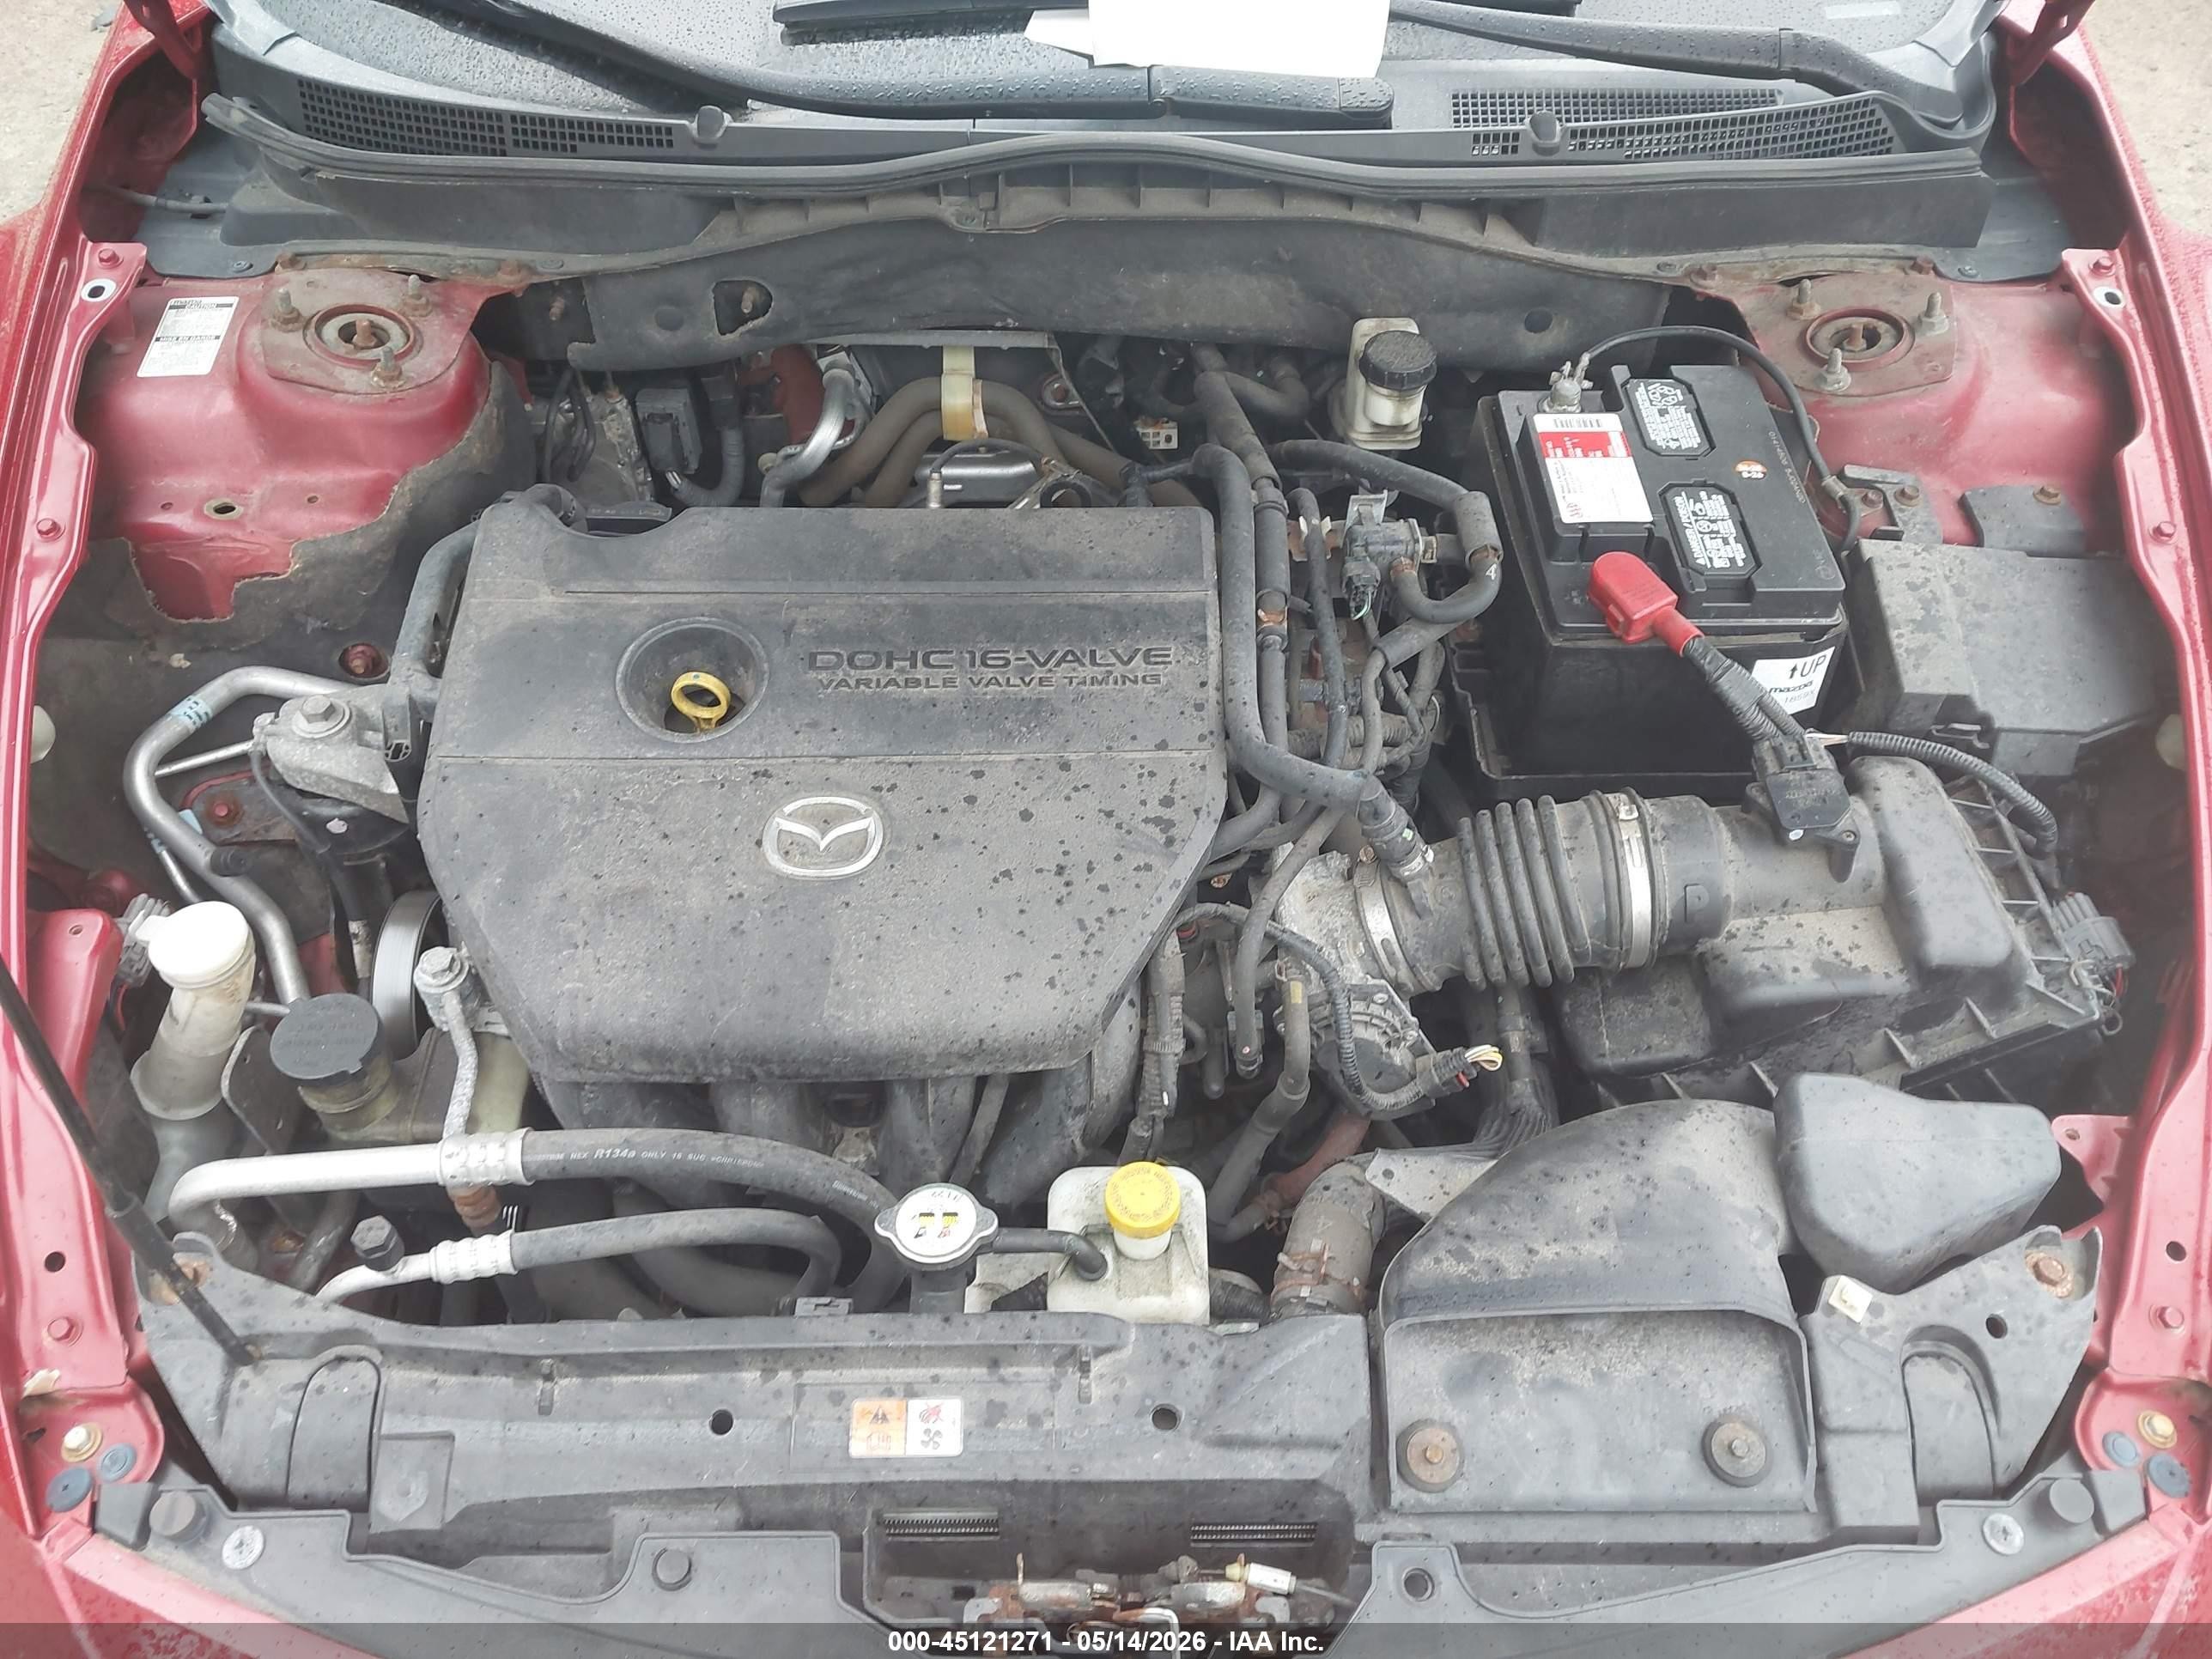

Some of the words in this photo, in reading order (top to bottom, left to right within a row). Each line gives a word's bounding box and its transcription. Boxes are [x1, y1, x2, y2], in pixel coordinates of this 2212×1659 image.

[808, 650, 954, 671] DOHC
[967, 646, 1174, 670] 16-VALVE
[1800, 654, 1826, 678] UP
[818, 676, 958, 690] VARIABLE
[969, 675, 1054, 689] VALVE
[1063, 672, 1163, 688] TIMING
[593, 1148, 636, 1159] R134a
[641, 1151, 666, 1159] ONLY
